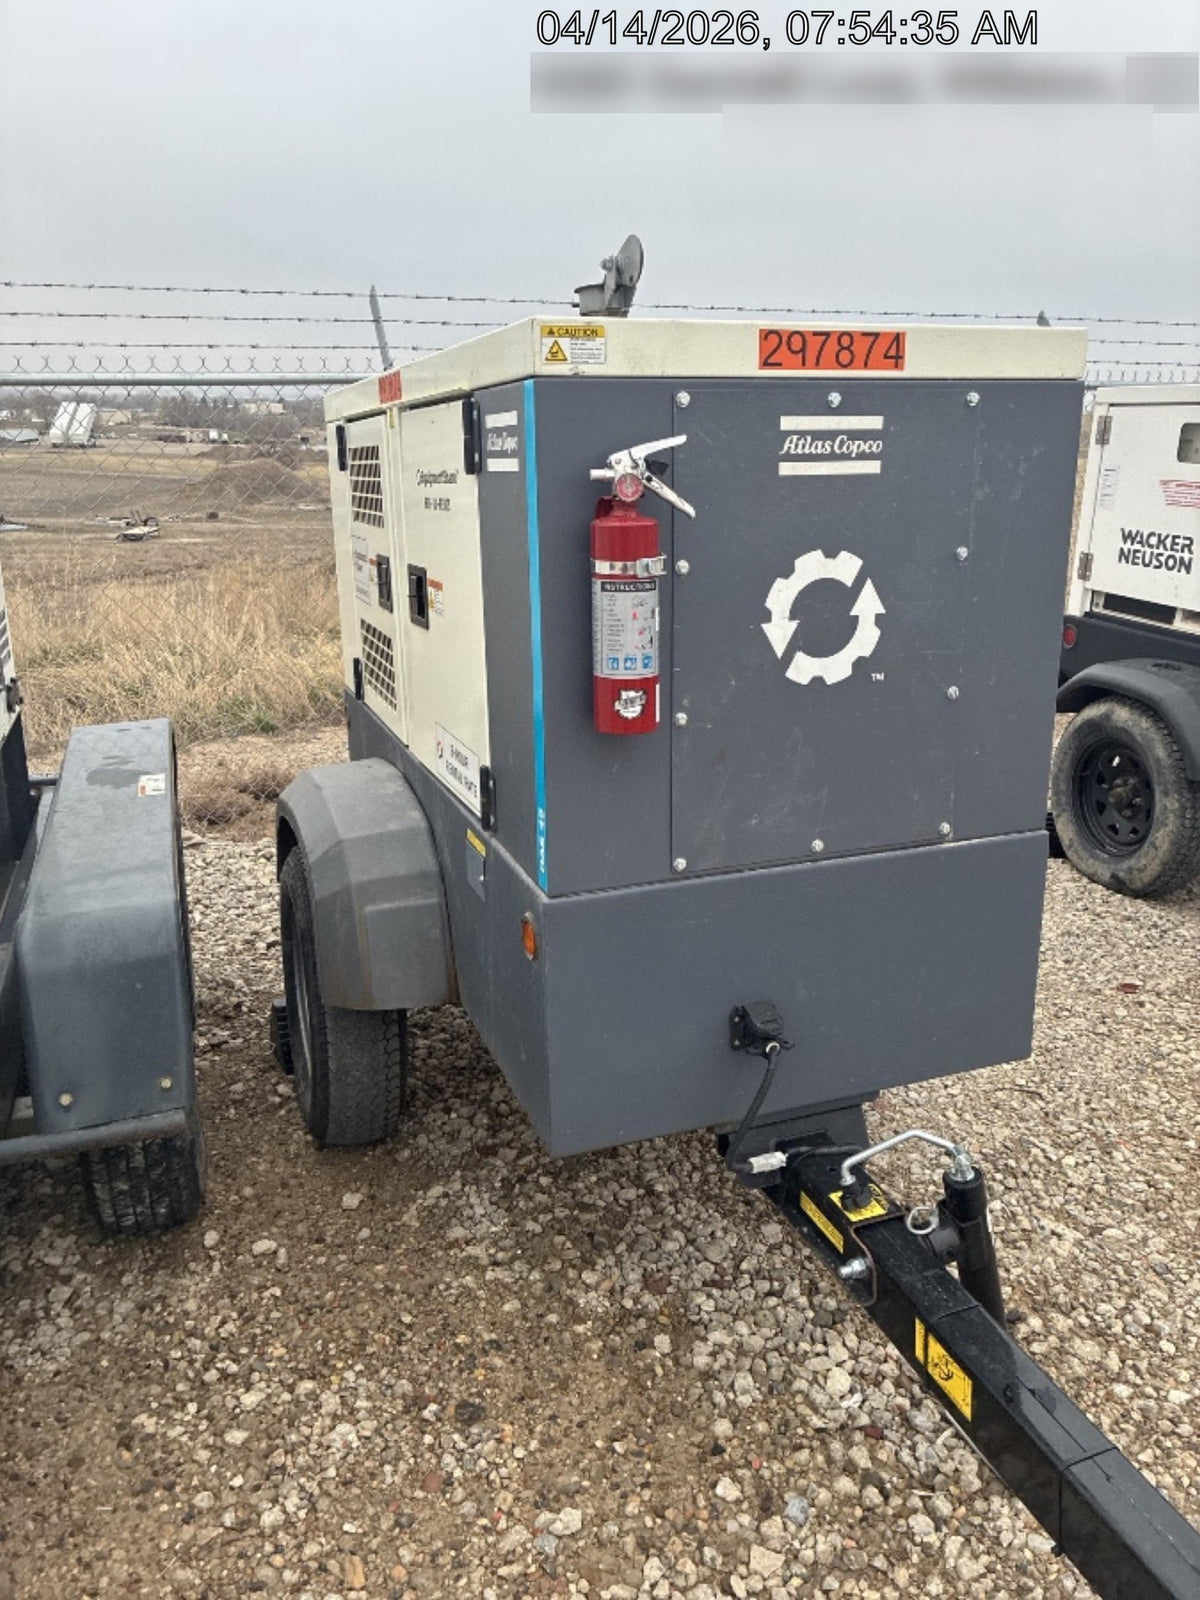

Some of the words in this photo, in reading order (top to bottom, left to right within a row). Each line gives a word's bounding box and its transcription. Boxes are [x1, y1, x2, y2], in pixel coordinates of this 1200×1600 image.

[557, 327, 598, 337] CAUTION
[761, 329, 905, 369] 297874
[779, 435, 832, 457] Atlas
[831, 435, 883, 459] Copco
[1120, 527, 1194, 555] WACKER
[1118, 547, 1193, 575] NEUSON
